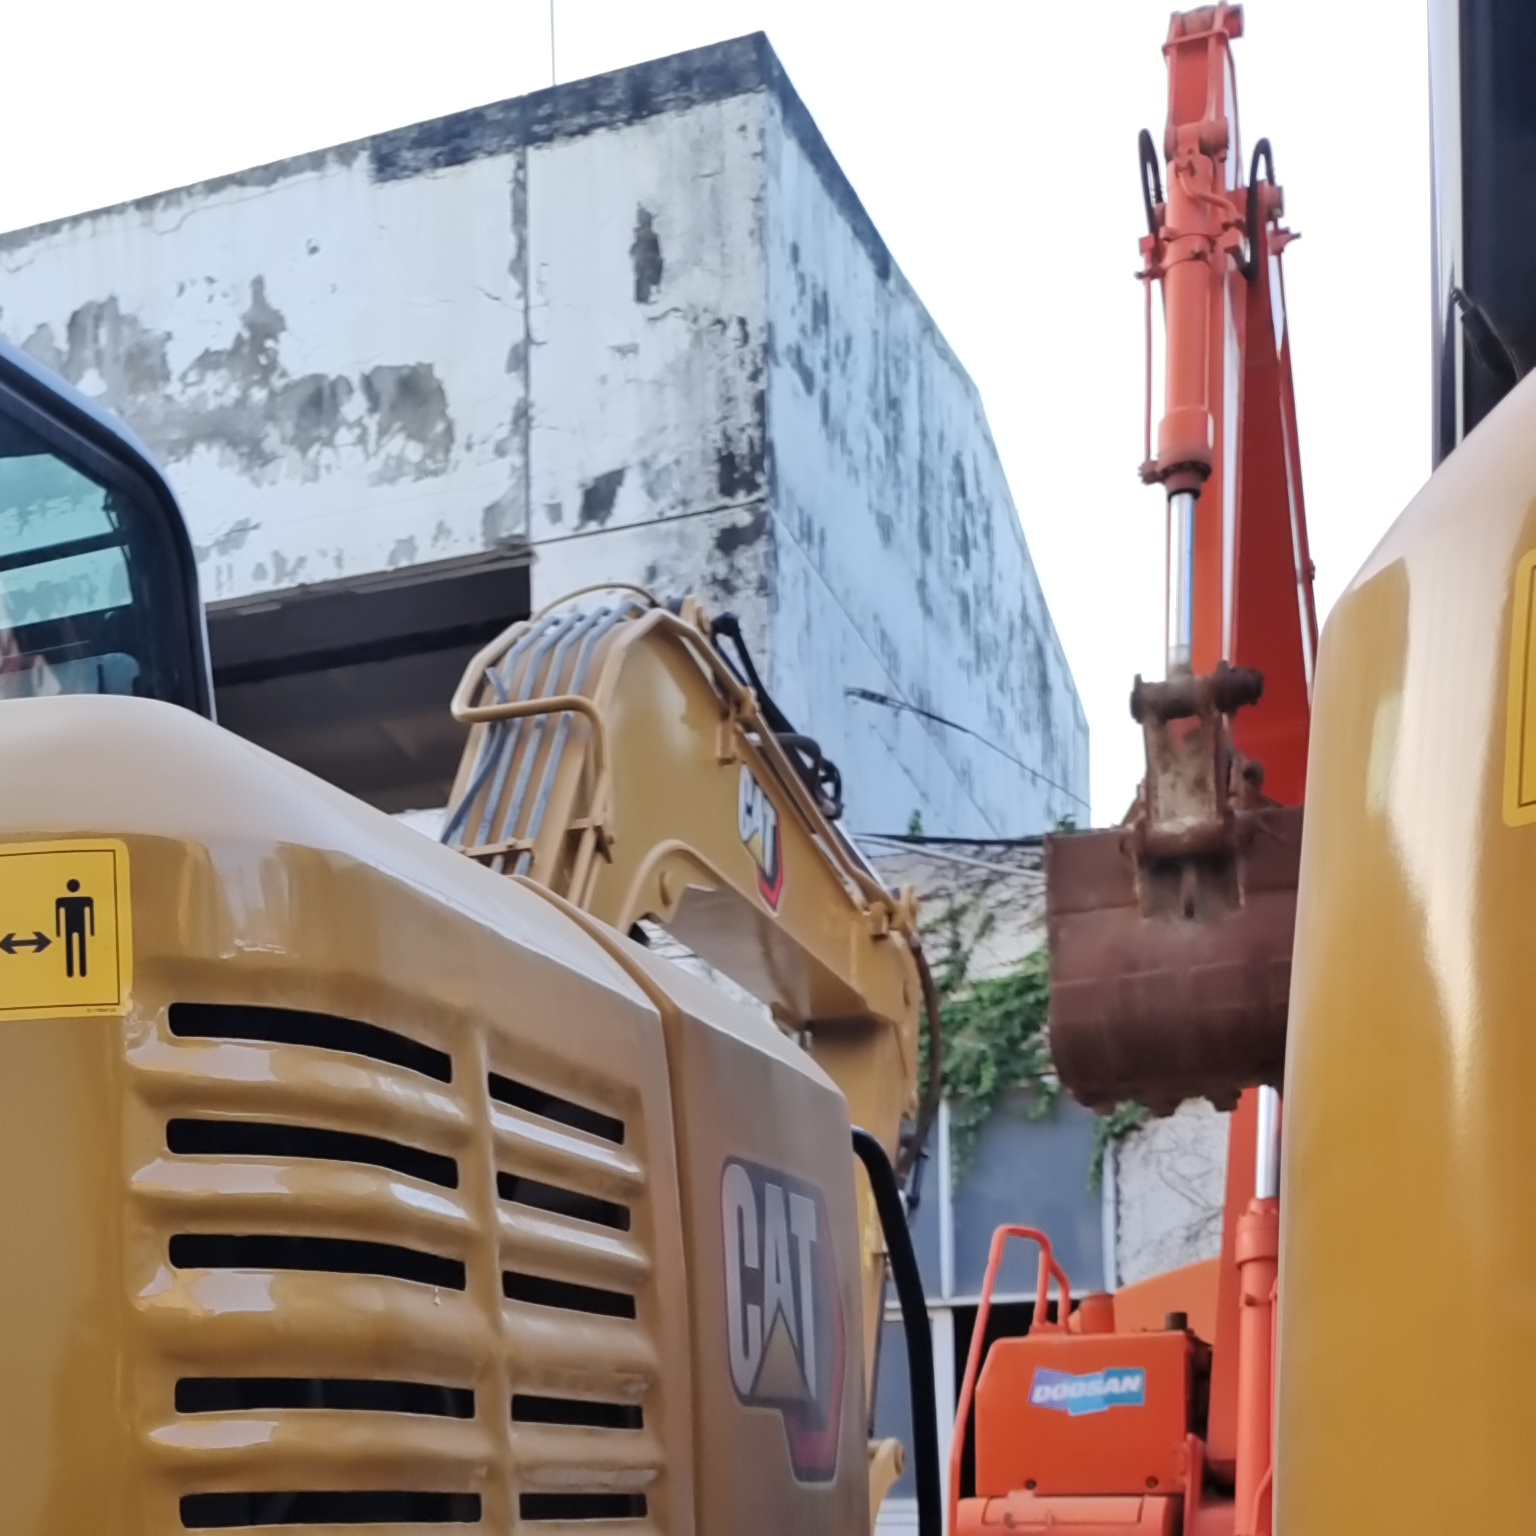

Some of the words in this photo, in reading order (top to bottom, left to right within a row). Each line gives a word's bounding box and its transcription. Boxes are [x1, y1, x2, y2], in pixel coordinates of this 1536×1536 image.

[738, 763, 776, 877] CAT
[721, 1163, 817, 1399] CAT
[1031, 1374, 1142, 1404] DOOSAN
